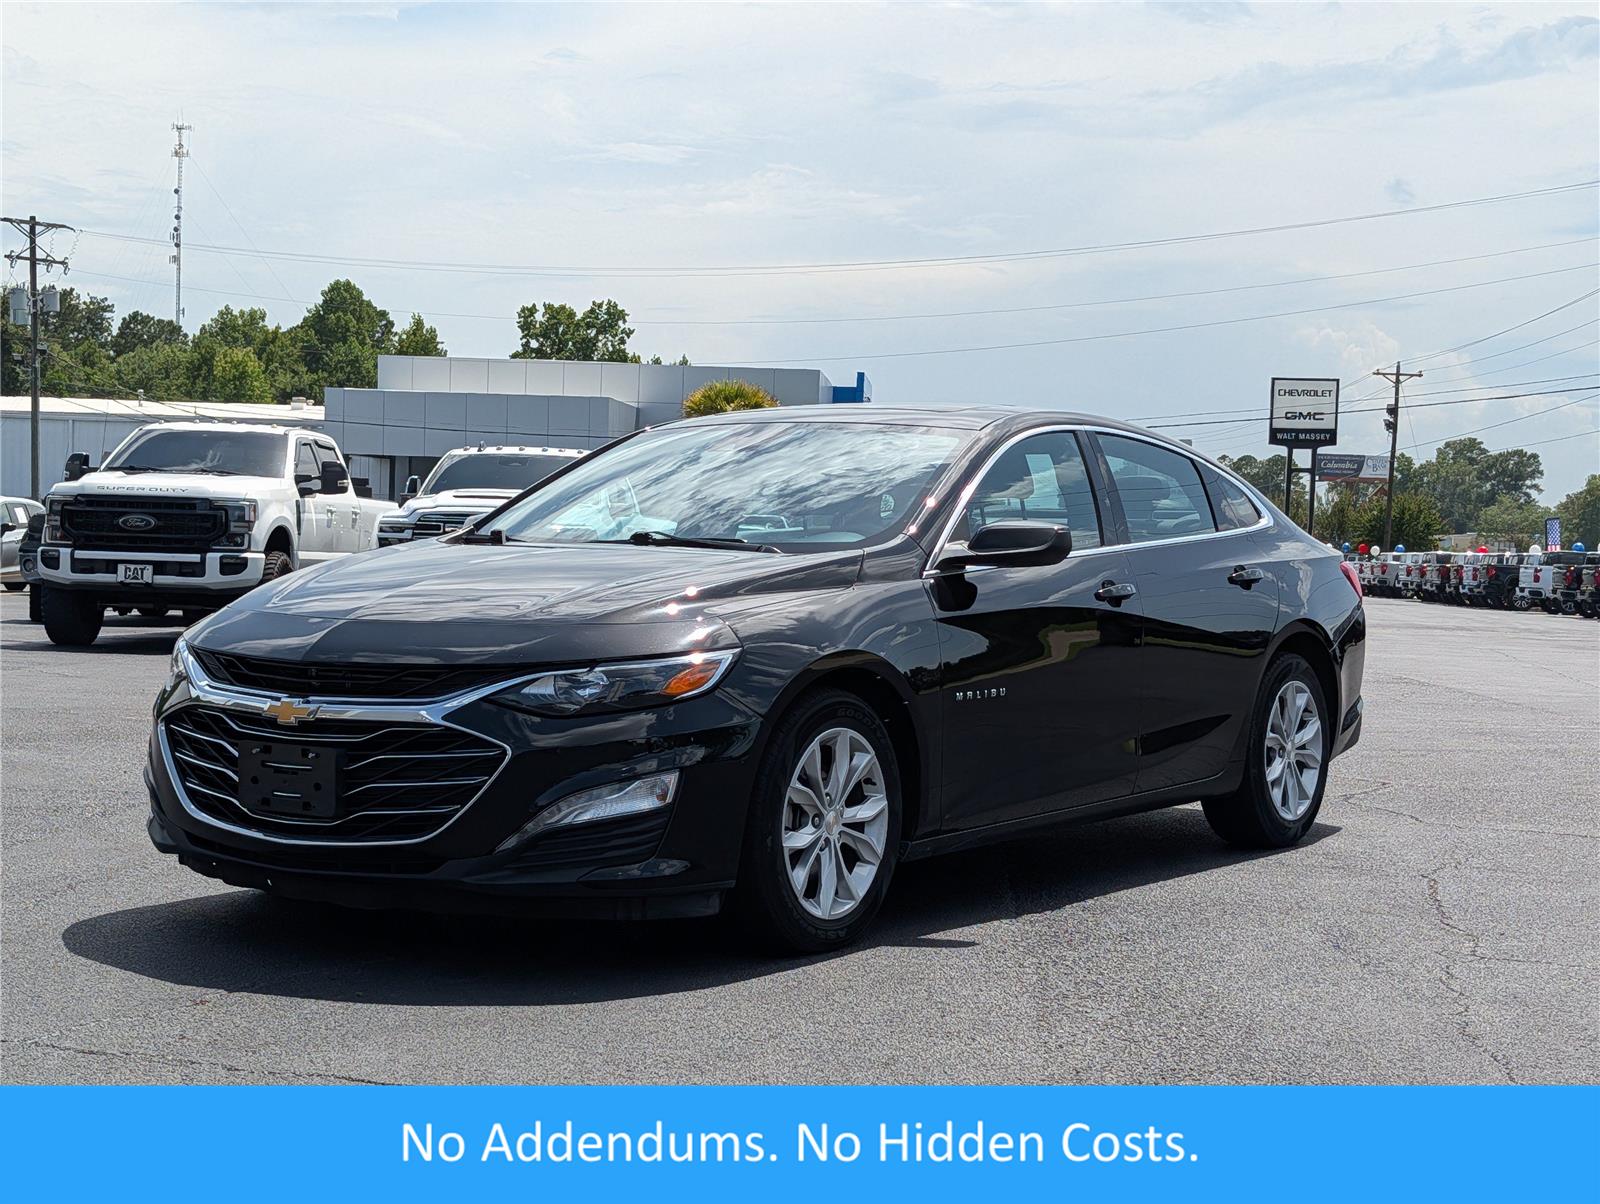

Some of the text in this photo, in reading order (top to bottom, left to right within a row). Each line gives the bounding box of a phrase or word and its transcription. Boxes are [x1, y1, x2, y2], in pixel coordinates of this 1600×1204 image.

[1277, 388, 1333, 398] CHEVROLET
[1284, 411, 1325, 421] GMC
[1276, 432, 1331, 441] WALT MASSEY
[1321, 460, 1358, 469] Columbia
[124, 565, 147, 581] CAT
[955, 687, 1006, 701] MALIBU
